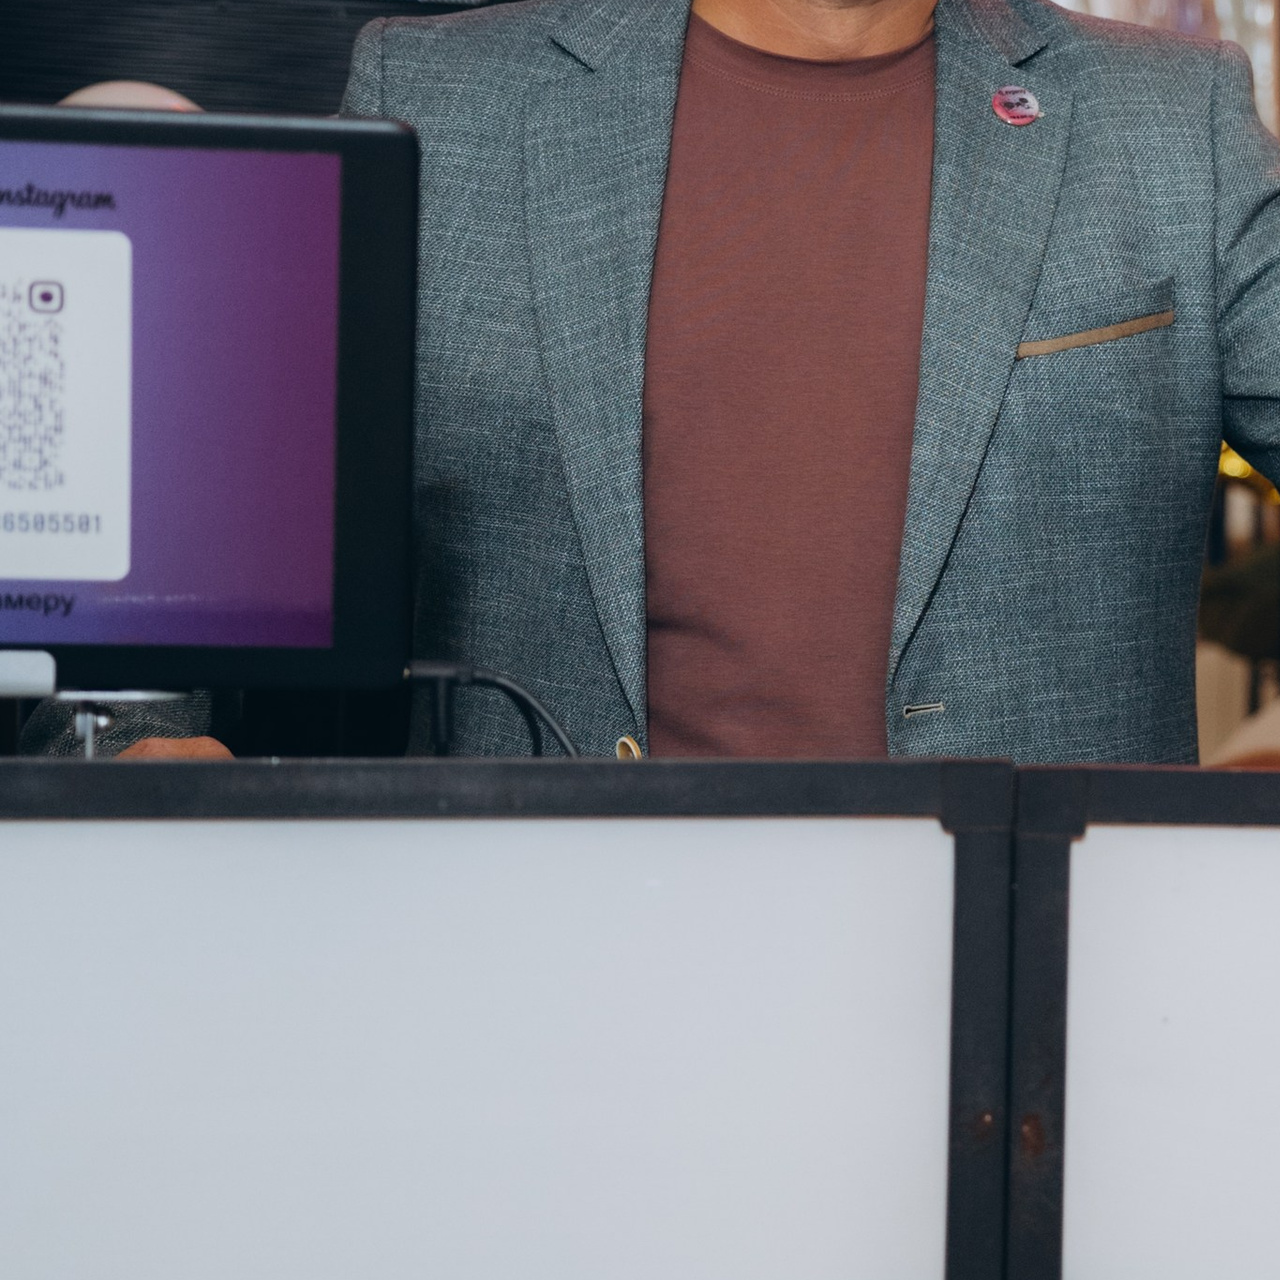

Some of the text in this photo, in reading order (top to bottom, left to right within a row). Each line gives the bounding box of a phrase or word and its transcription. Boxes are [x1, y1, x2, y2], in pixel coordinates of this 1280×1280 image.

[0, 182, 116, 218] nstagram
[2, 512, 102, 535] 6505501
[0, 593, 75, 617] меру
